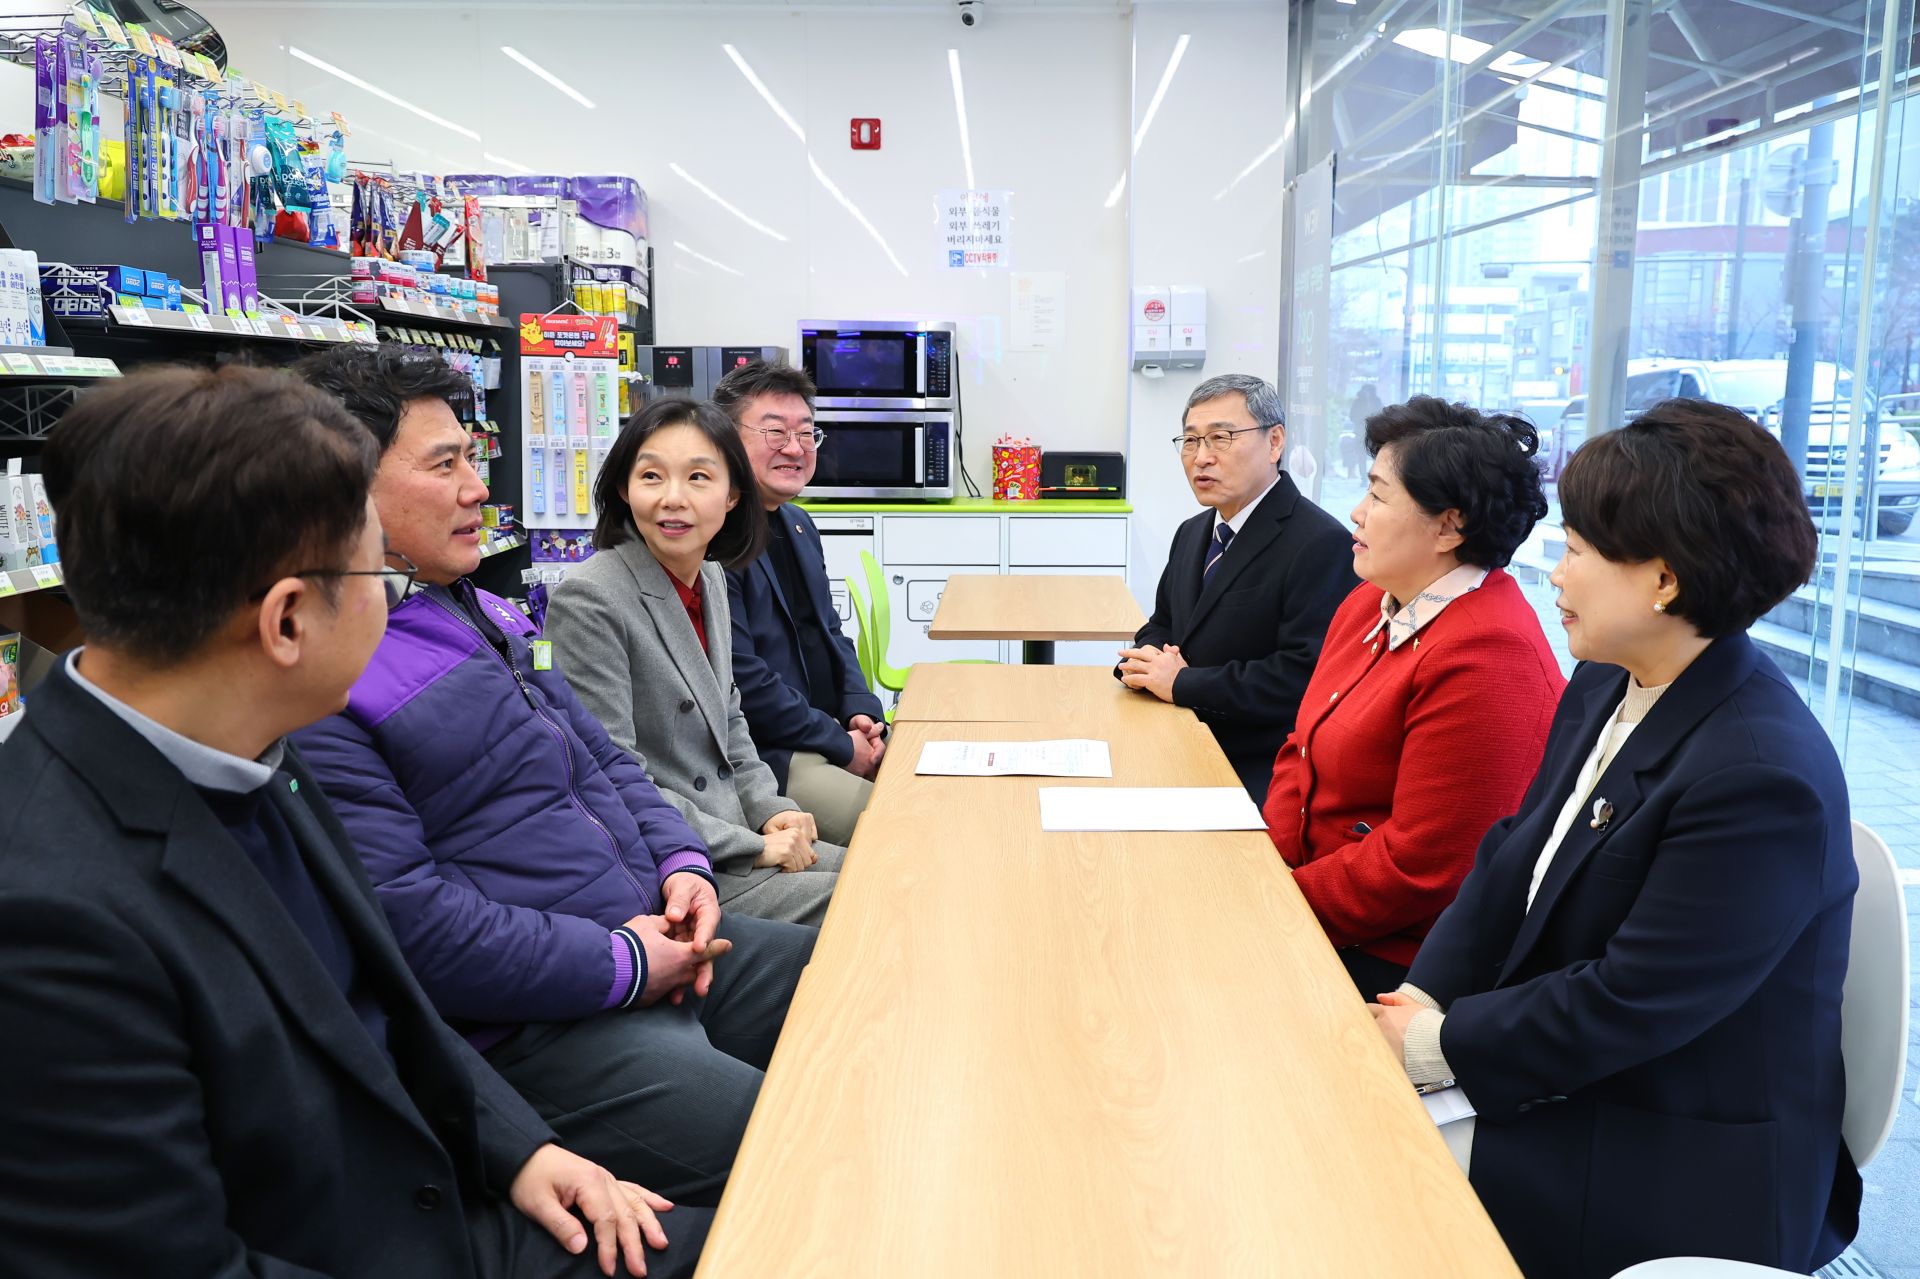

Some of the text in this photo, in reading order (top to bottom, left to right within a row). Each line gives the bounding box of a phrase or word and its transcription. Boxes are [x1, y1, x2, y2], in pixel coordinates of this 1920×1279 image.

[949, 206, 967, 217] 외부
[949, 221, 967, 231] 외부
[947, 234, 1002, 245] 버리지마세요
